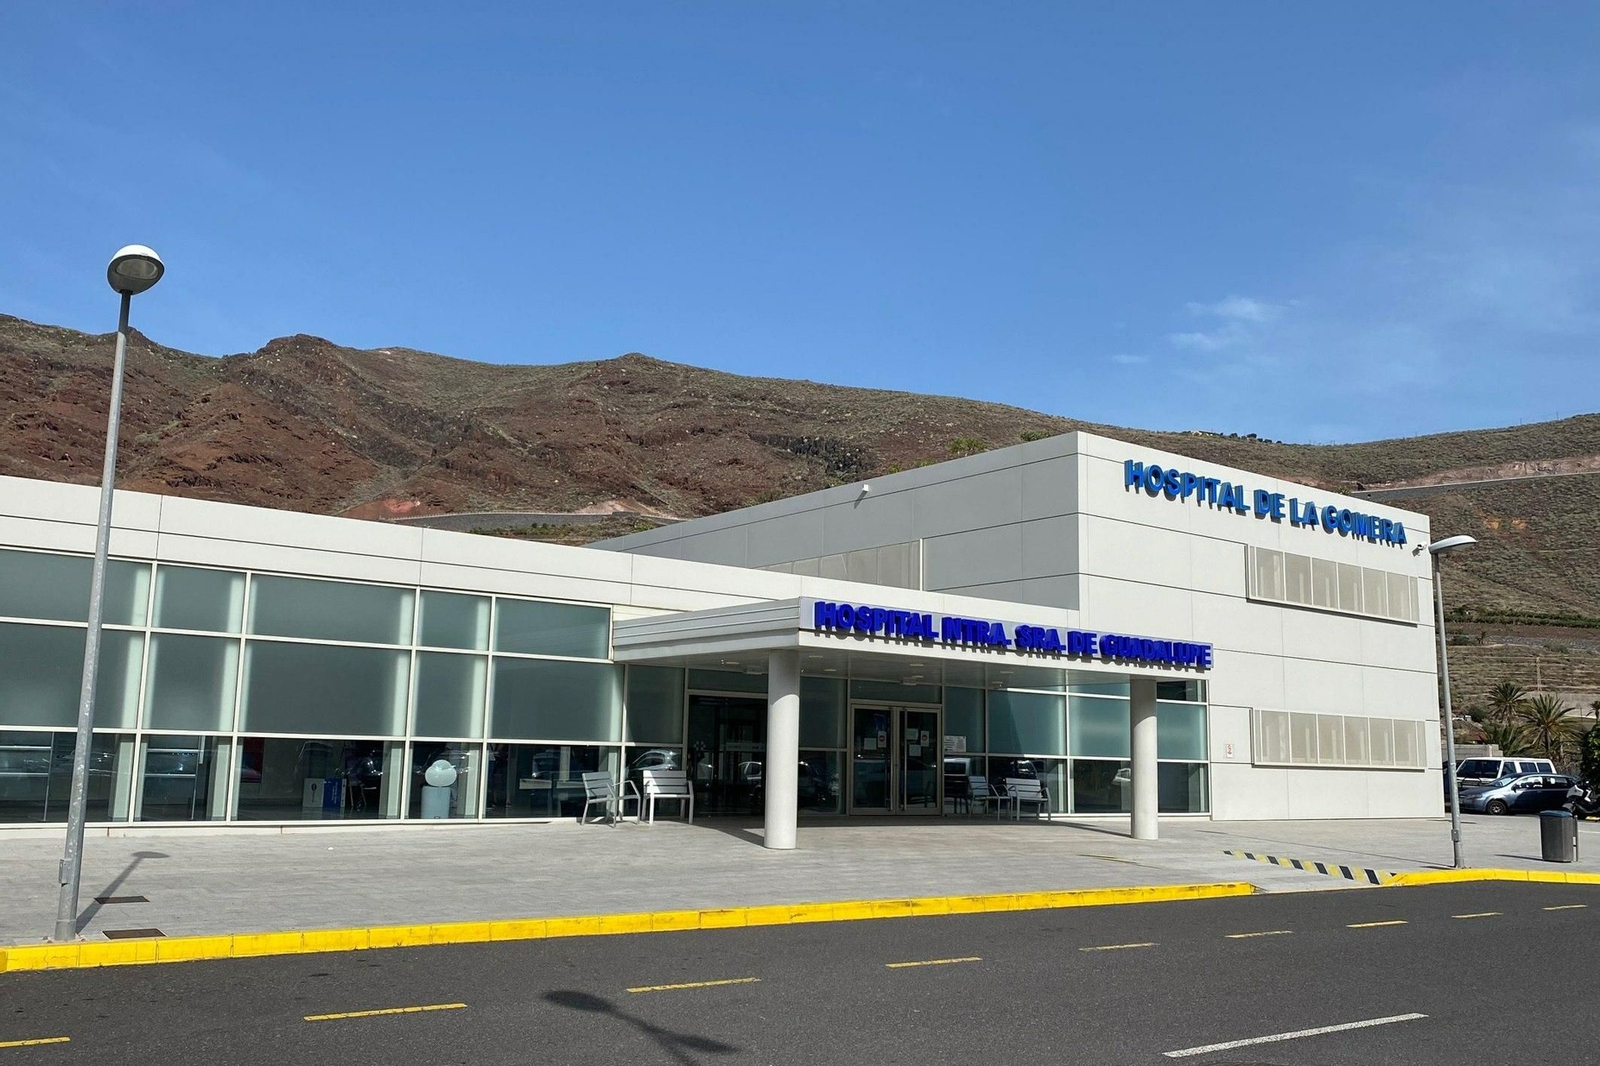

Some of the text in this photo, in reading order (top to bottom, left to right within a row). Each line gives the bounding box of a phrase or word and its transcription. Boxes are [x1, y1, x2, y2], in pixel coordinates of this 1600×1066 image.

[1124, 459, 1407, 545] HOSPITAL DE LA GOMERA
[814, 601, 1212, 668] HOSPITAL NTRA. SRA. DE GUADALUPE
